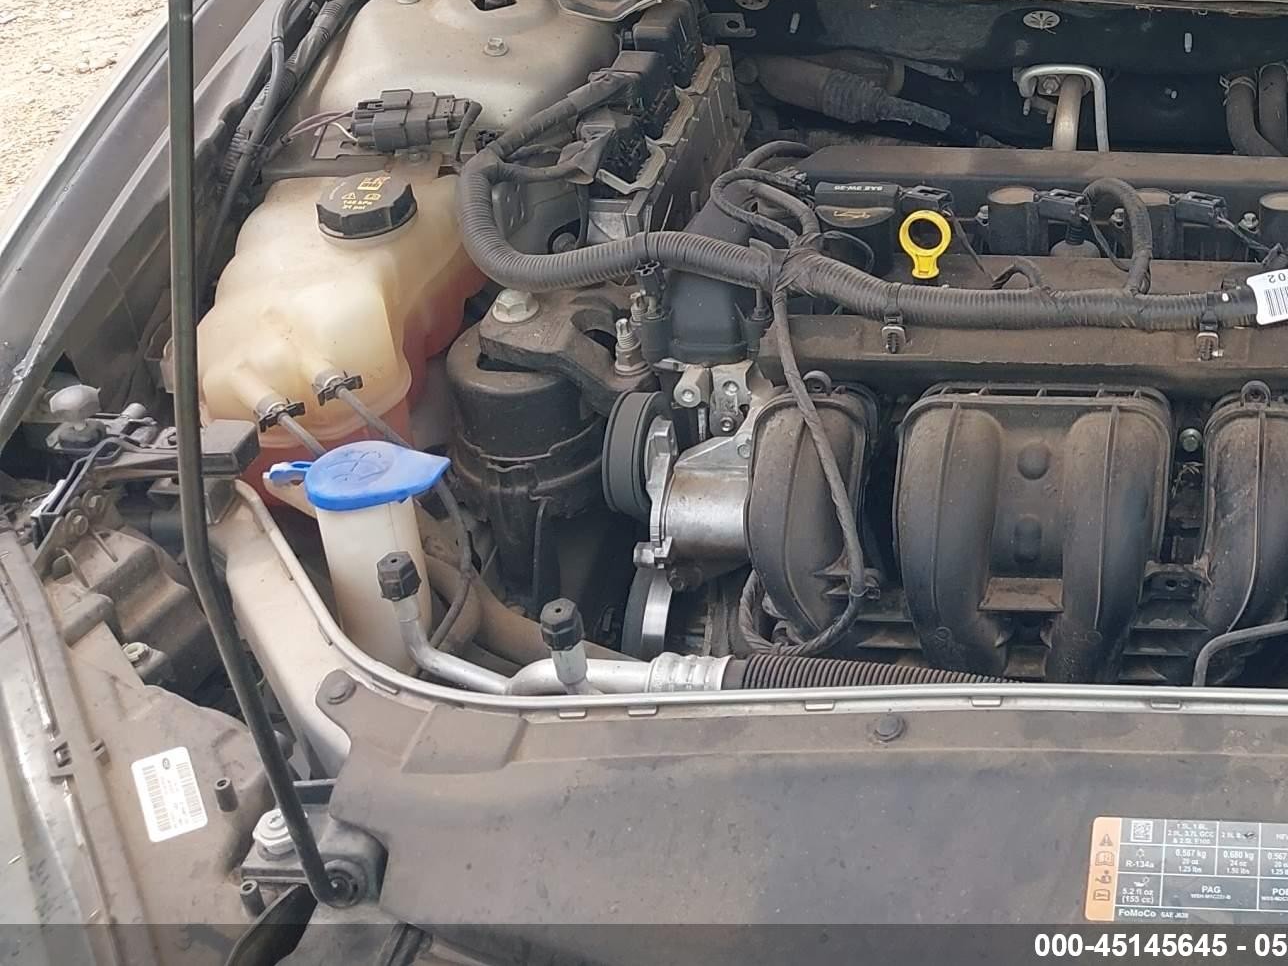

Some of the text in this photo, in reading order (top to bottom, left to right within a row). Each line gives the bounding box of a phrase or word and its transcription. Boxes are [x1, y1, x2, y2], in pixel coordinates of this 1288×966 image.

[1196, 849, 1207, 859] kg
[1244, 850, 1255, 861] kg
[1125, 859, 1155, 869] R-134a
[1122, 887, 1136, 895] 5.2
[1201, 885, 1222, 894] PAG
[1118, 908, 1157, 917] FoMoCo
